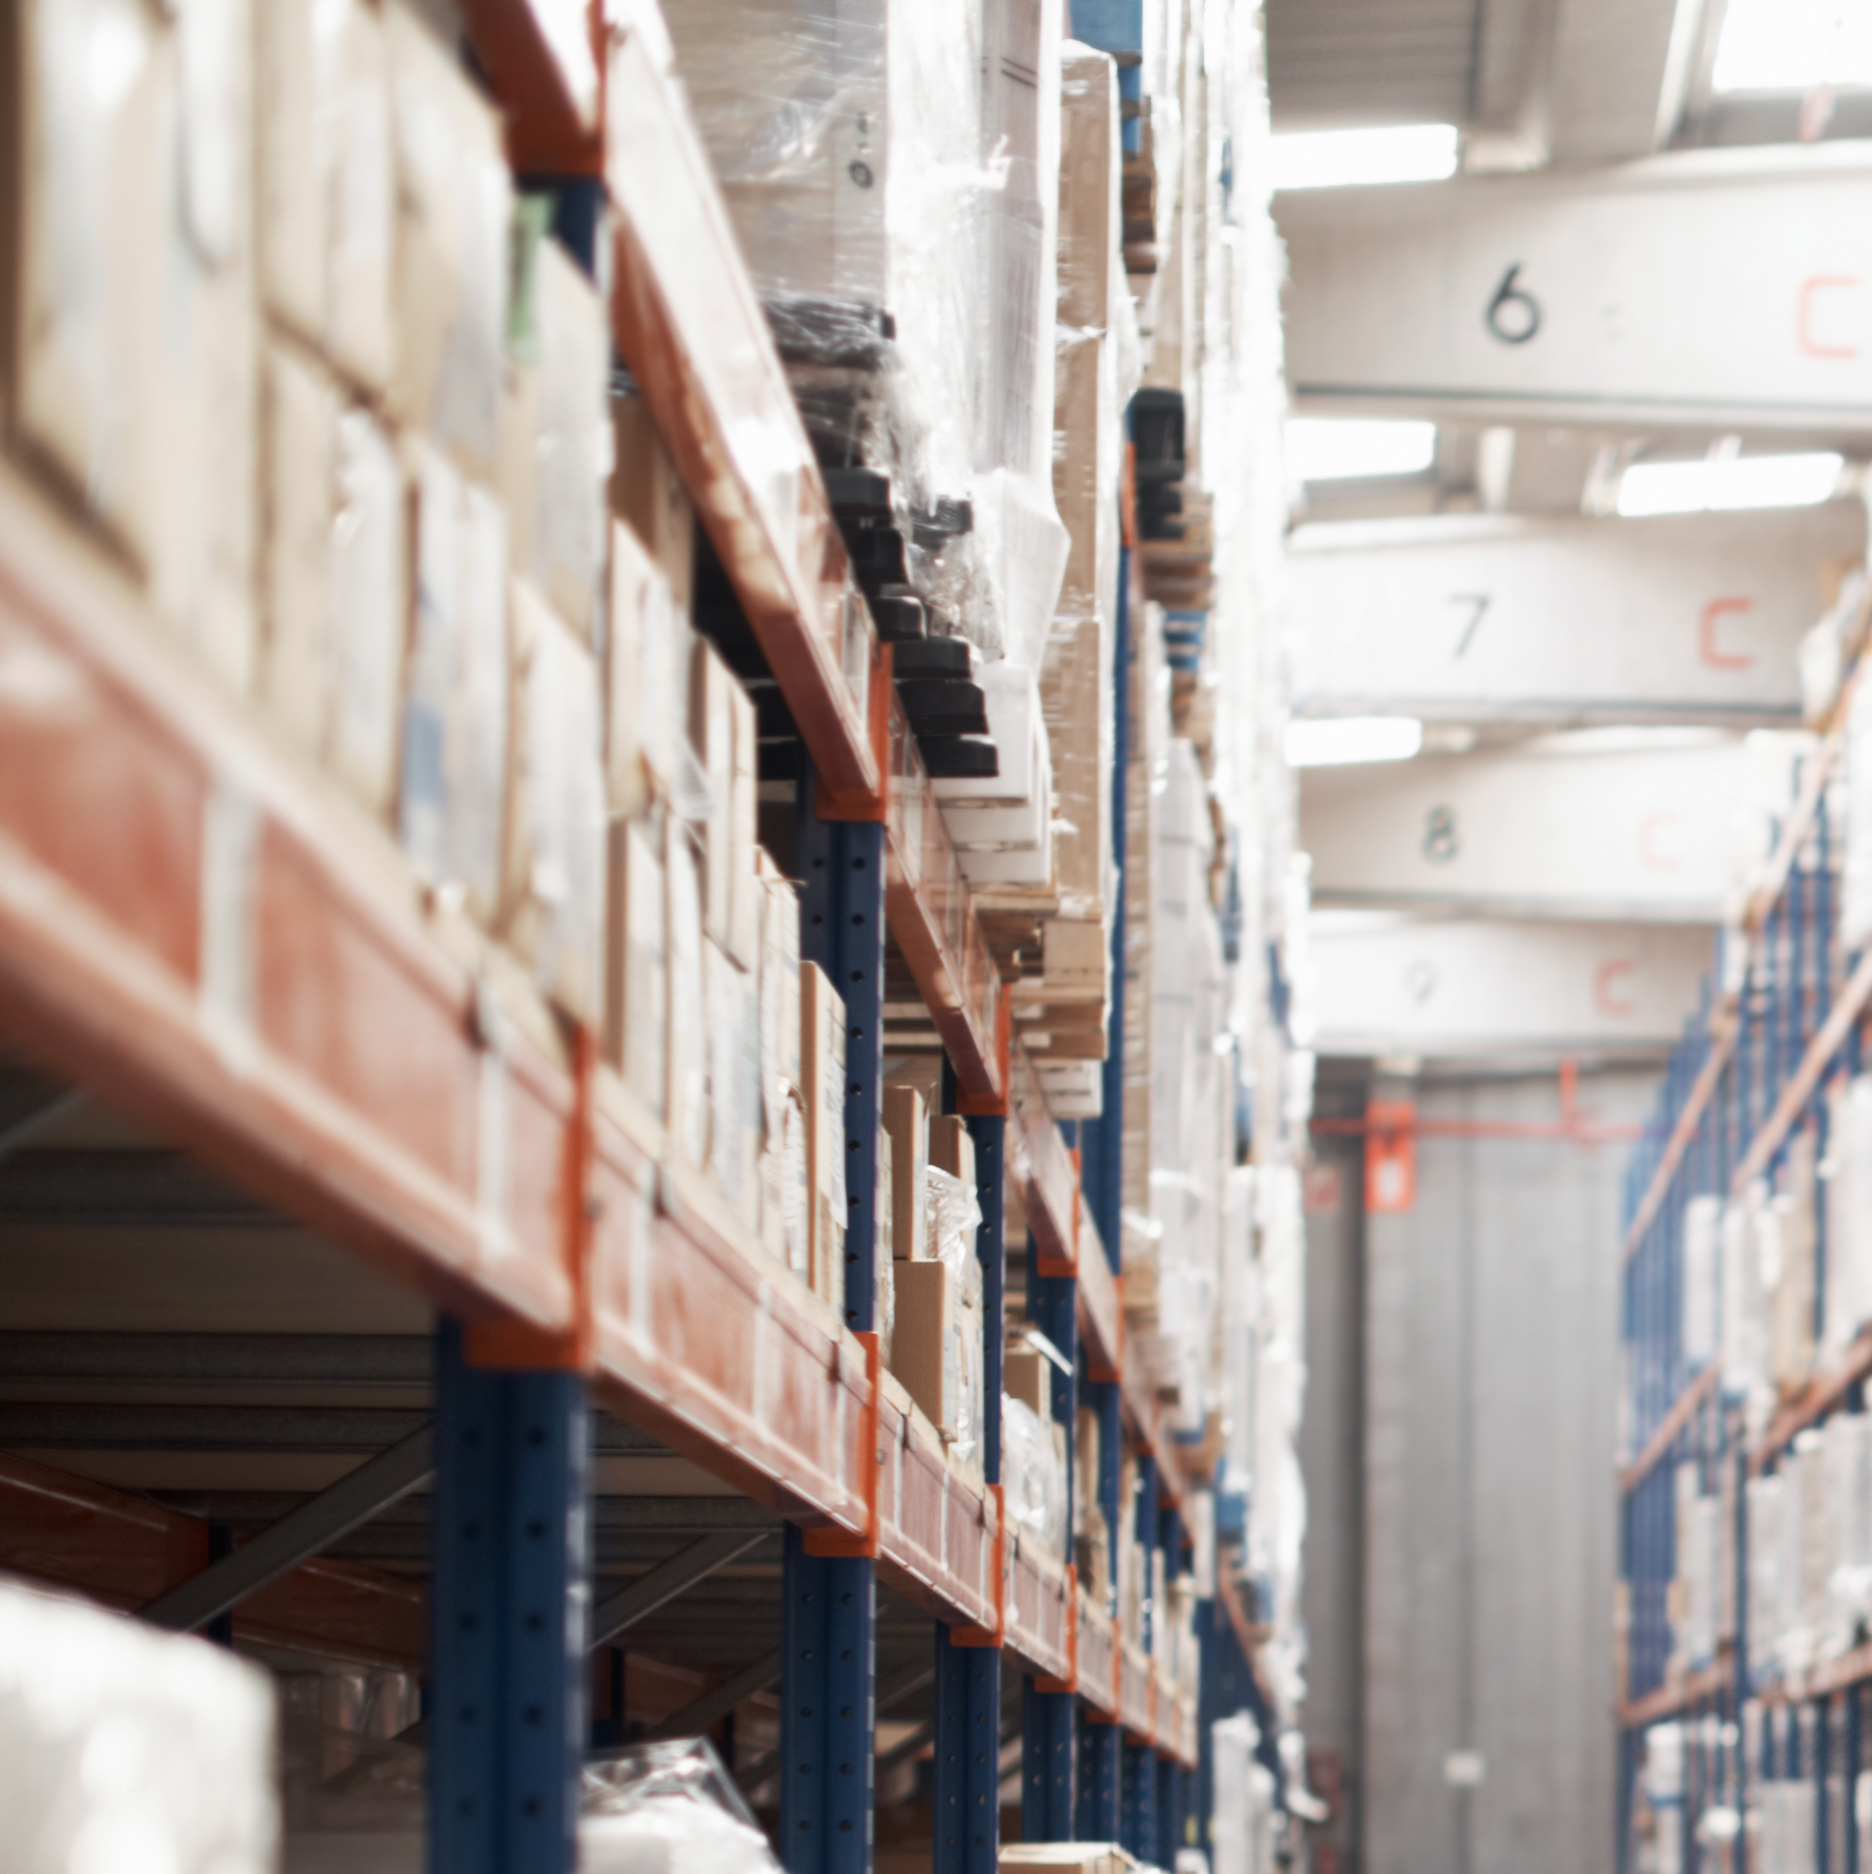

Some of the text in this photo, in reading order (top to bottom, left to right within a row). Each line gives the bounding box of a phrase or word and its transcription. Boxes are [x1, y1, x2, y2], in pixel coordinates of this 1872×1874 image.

[1484, 260, 1858, 359] 6 C
[1448, 594, 1754, 669] 7 C
[1421, 806, 1681, 871] 8 C
[1403, 959, 1635, 1018] 9 C
